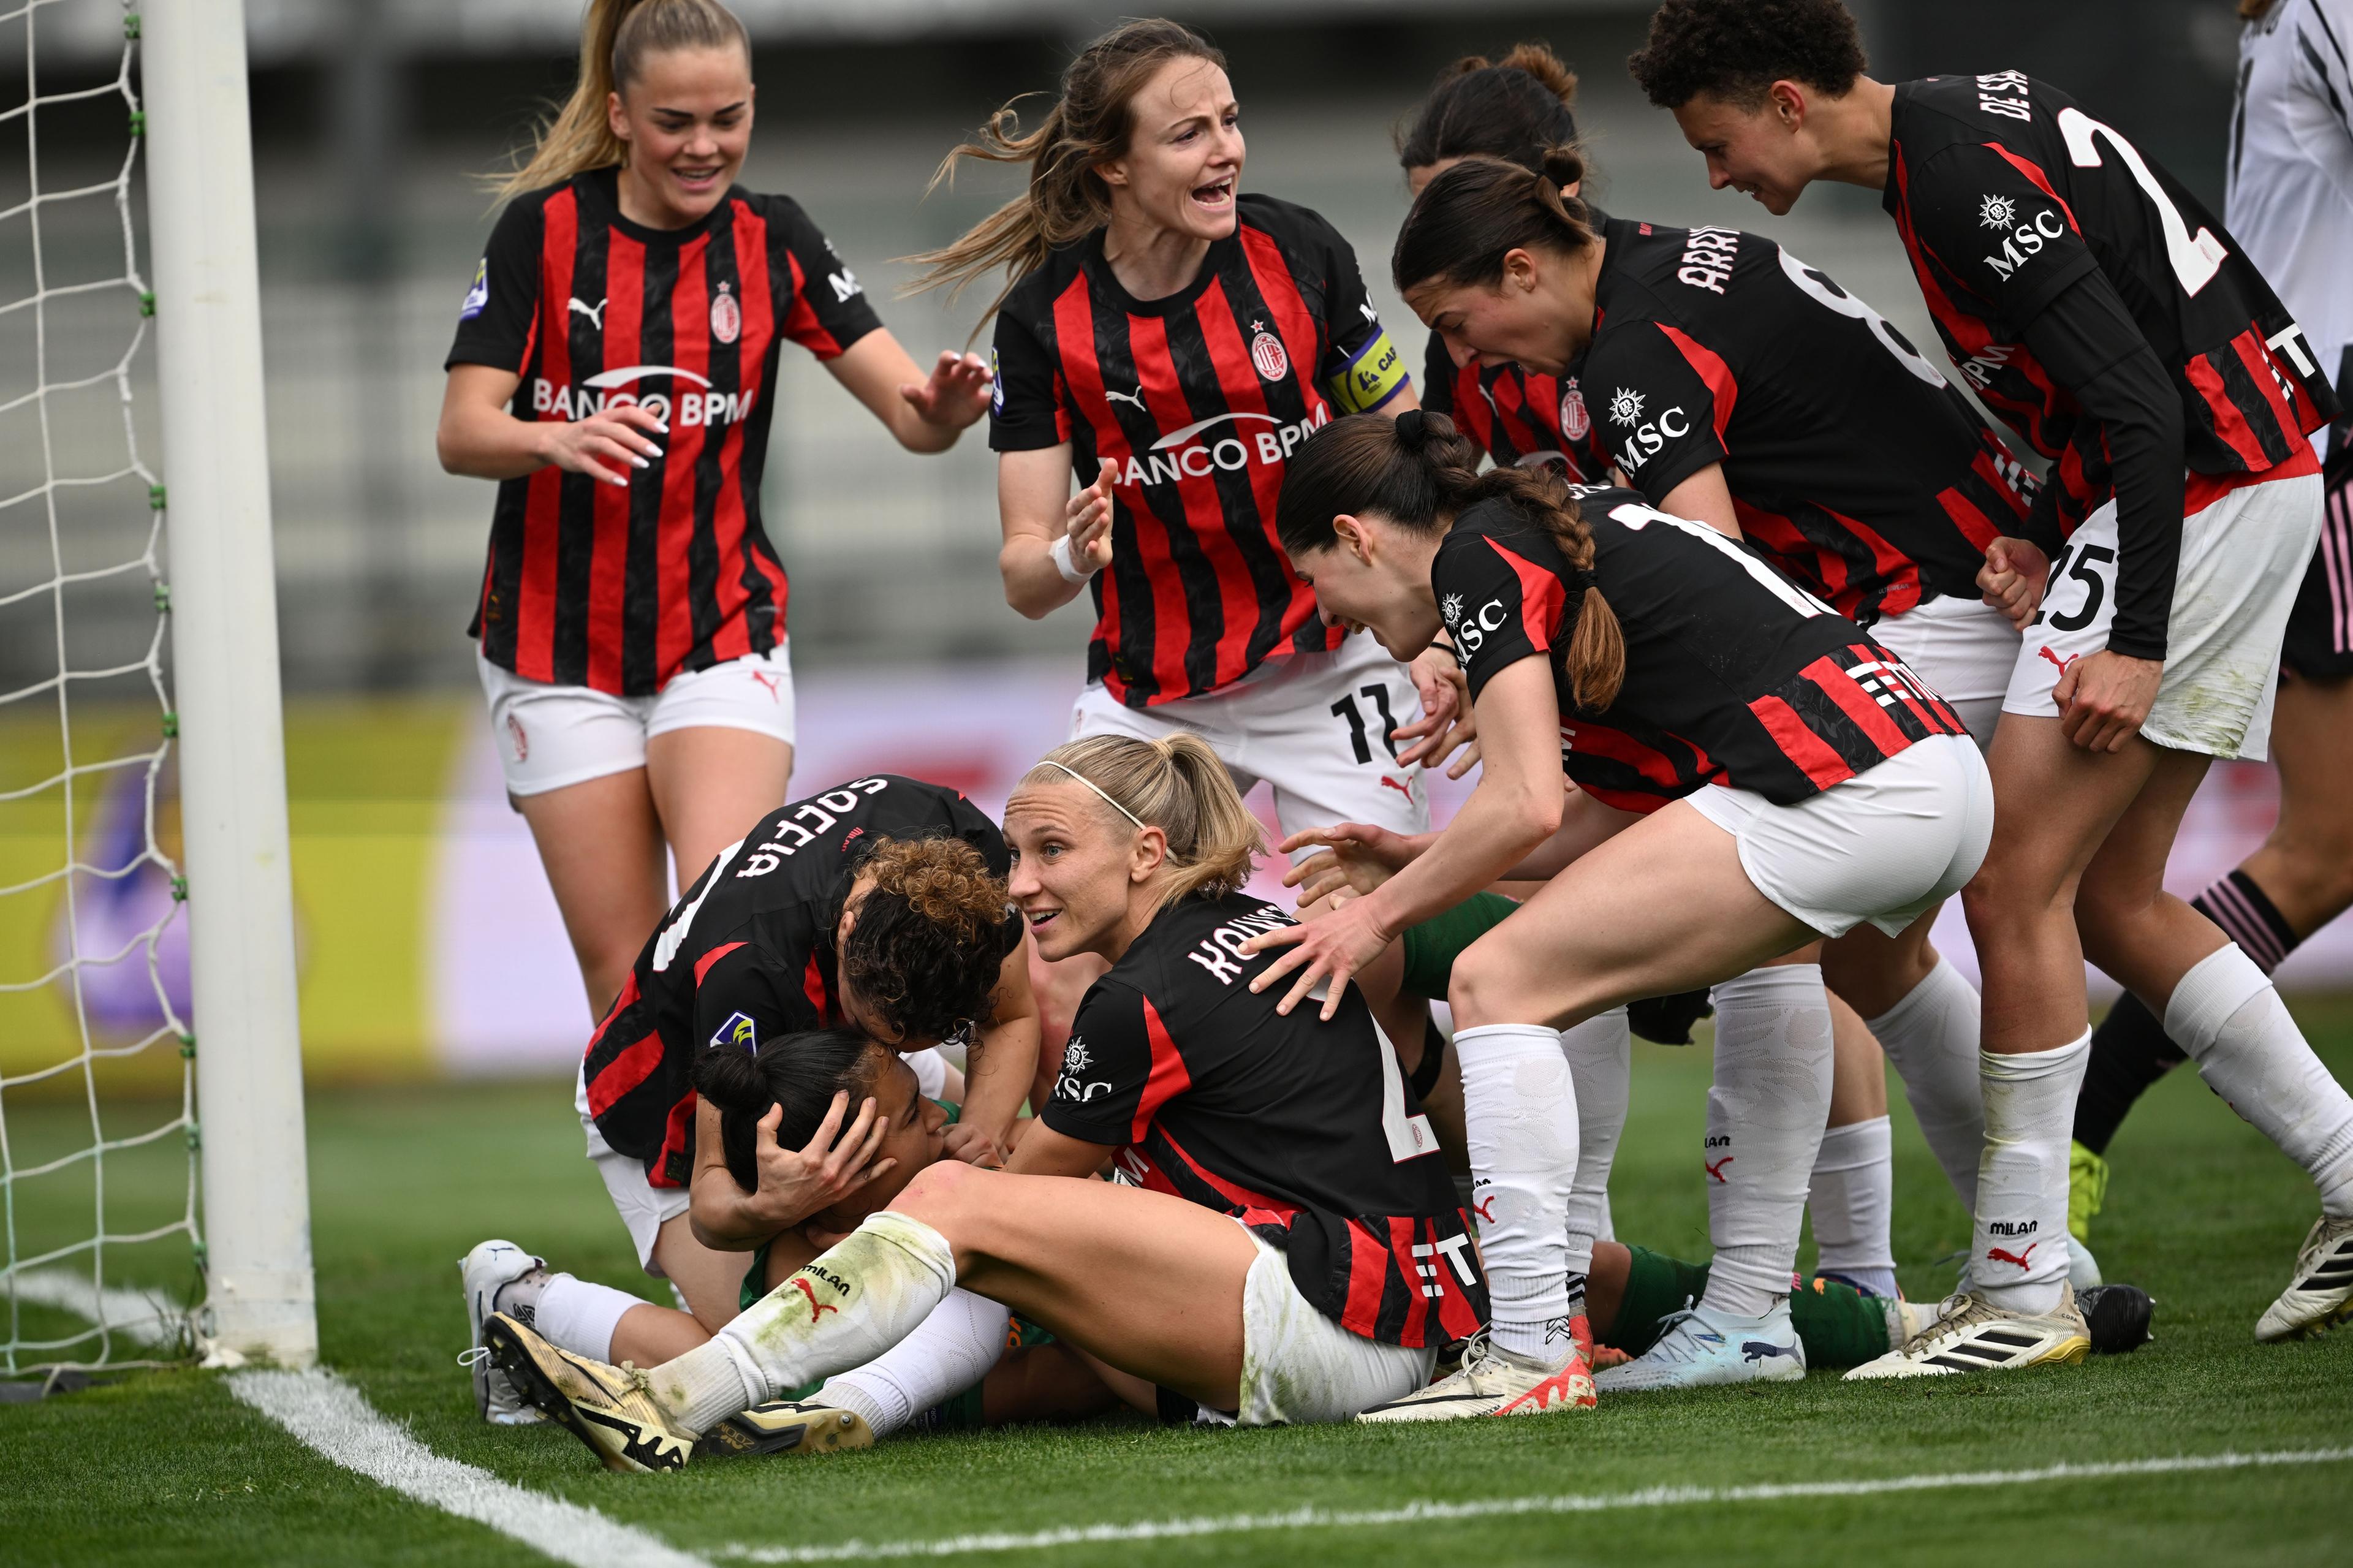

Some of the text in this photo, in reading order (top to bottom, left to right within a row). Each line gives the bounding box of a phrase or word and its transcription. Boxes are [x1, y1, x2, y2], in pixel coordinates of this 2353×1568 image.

[1983, 209, 2063, 282] MSC
[680, 389, 754, 428] BPM
[1613, 406, 1690, 480] MSC
[735, 778, 889, 879] SOFFIA
